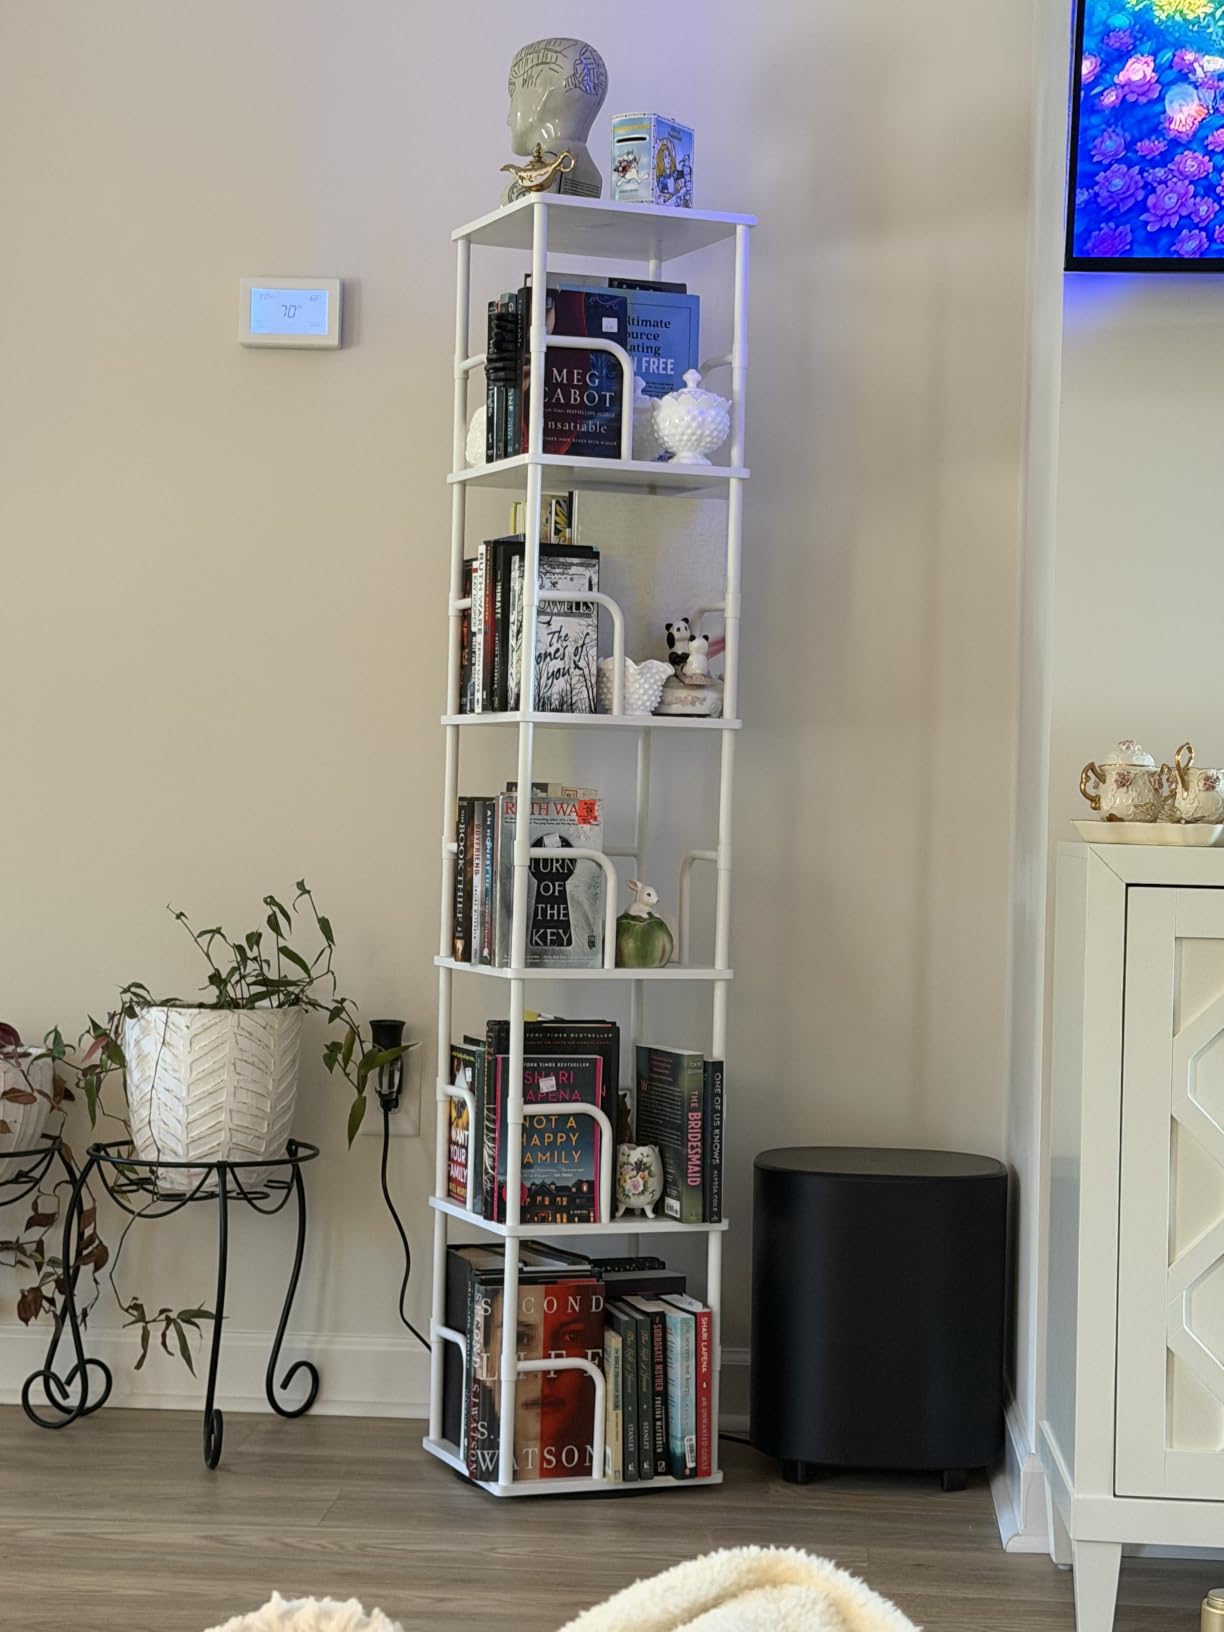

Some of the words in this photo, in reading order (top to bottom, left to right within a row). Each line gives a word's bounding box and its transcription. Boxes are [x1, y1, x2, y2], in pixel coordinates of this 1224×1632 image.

[628, 315, 671, 329] ltimate
[629, 342, 661, 357] ating
[642, 357, 675, 375] FREE
[552, 367, 600, 387] MEG
[548, 419, 608, 433] nsatiable
[536, 599, 595, 613] OWELLS
[546, 624, 569, 648] The
[536, 645, 569, 666] ones
[573, 632, 590, 663] of
[544, 667, 571, 695] you
[486, 809, 492, 825] AN
[504, 801, 550, 816] RTH
[553, 801, 578, 817] WA
[532, 857, 575, 873] TURN
[540, 881, 564, 896] OF
[536, 903, 569, 920] THE
[532, 928, 571, 947] KEY
[526, 1088, 581, 1102] APENA
[713, 1097, 721, 1111] OF
[522, 1116, 558, 1129] NOT
[567, 1116, 577, 1129] A
[713, 1113, 720, 1127] US
[451, 1127, 469, 1147] WANT
[449, 1144, 467, 1164] YOUR
[687, 1112, 702, 1186] BRIDESMAID
[712, 1129, 720, 1165] KNOWS
[523, 1150, 581, 1164] AMILY
[449, 1162, 468, 1183] AMILY
[481, 1295, 604, 1315] SCOND
[473, 1292, 482, 1368] SECOND
[653, 1324, 662, 1362] SURROGATE
[655, 1364, 663, 1392] MOTHER
[477, 1421, 494, 1439] S.
[469, 1406, 478, 1473] WATSON
